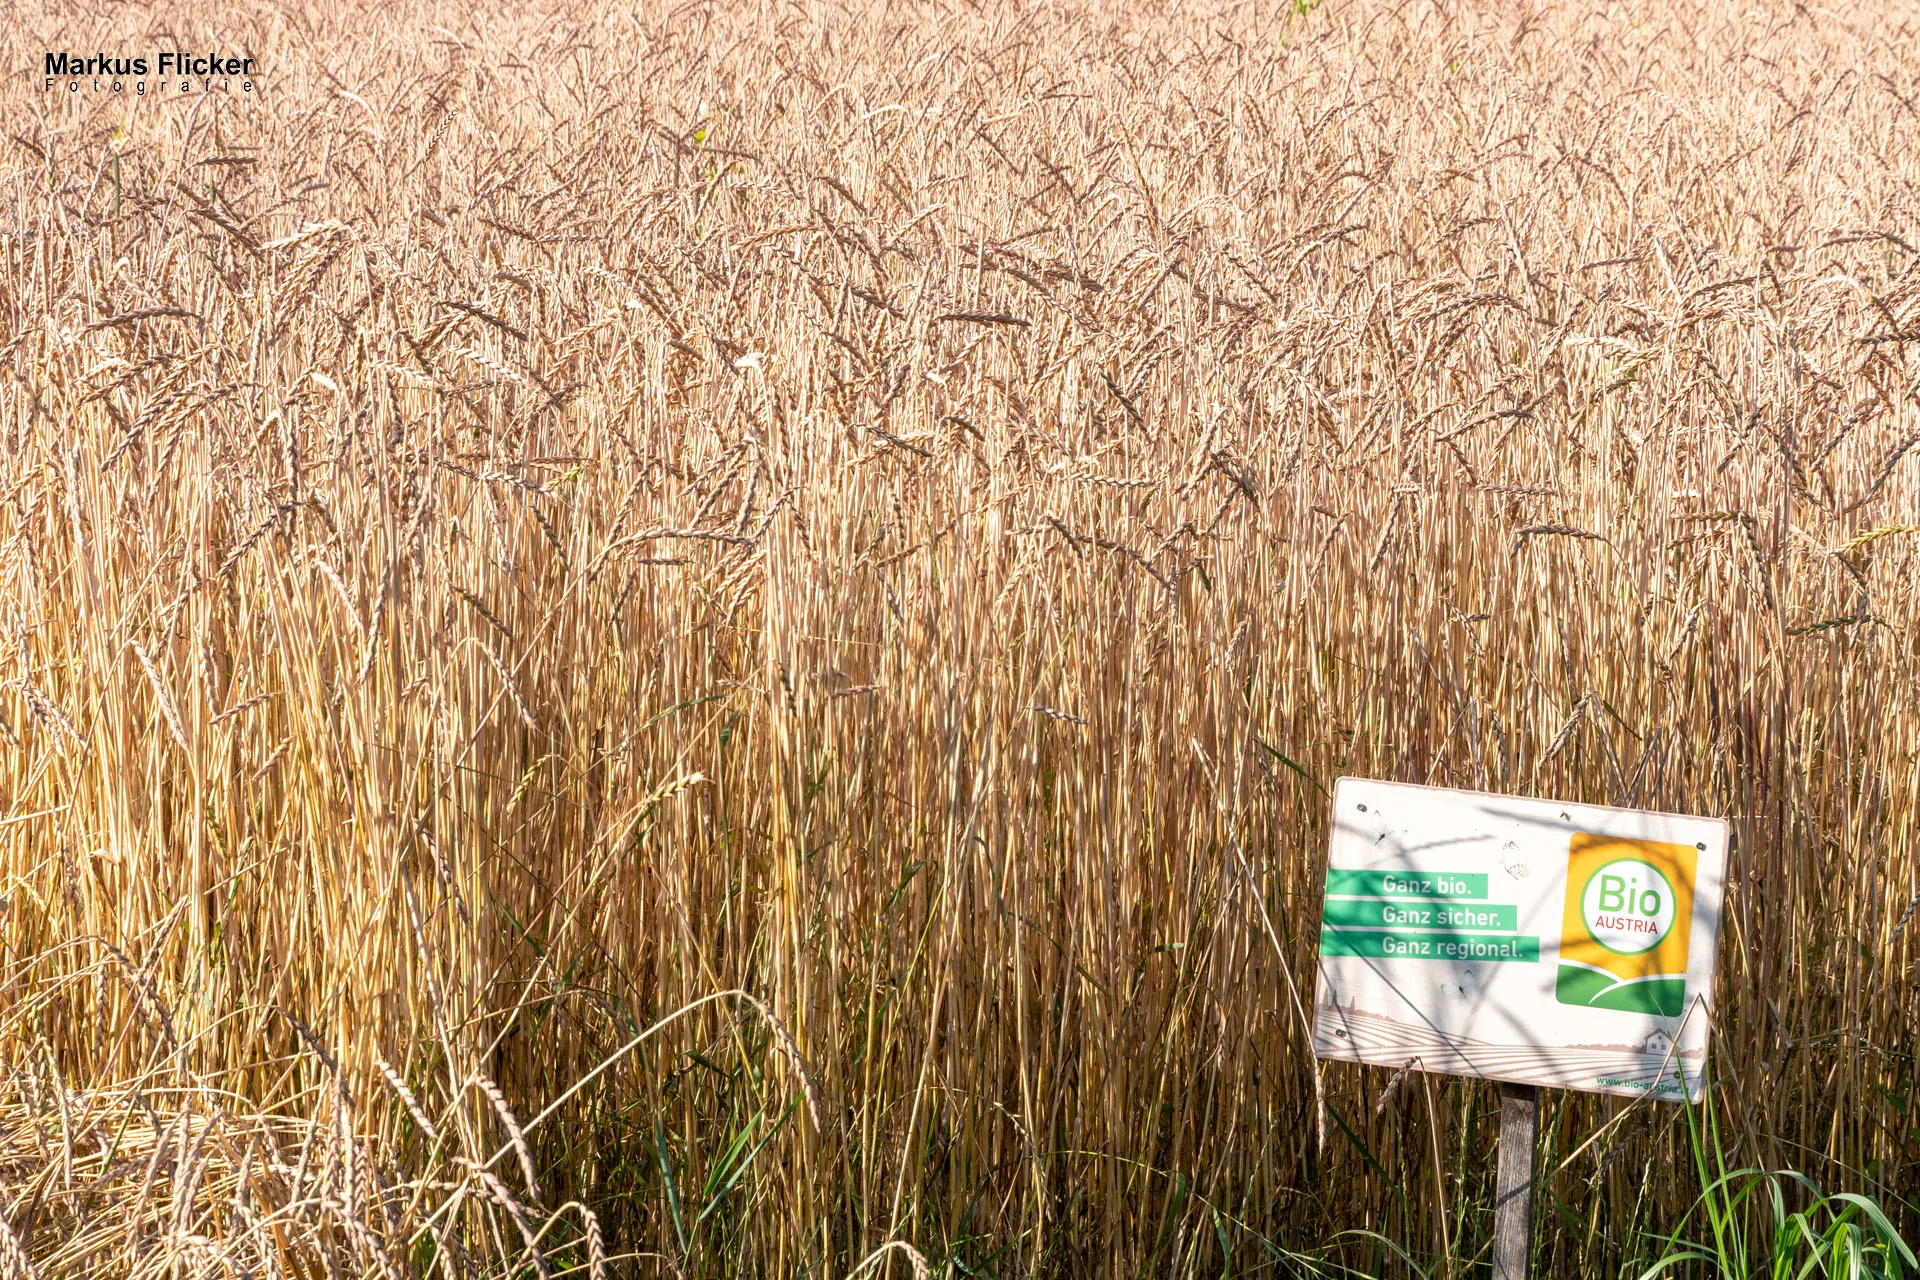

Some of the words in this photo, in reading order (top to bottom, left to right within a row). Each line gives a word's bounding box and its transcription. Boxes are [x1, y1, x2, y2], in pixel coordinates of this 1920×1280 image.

[1383, 875, 1431, 893] Ganz
[1437, 877, 1472, 894] bio.
[1598, 874, 1661, 917] Bio
[1383, 906, 1431, 924] Ganz
[1437, 908, 1501, 926] sicher.
[1595, 915, 1658, 935] AUSTRIA
[1382, 936, 1431, 955] Ganz
[1437, 939, 1523, 959] regional.
